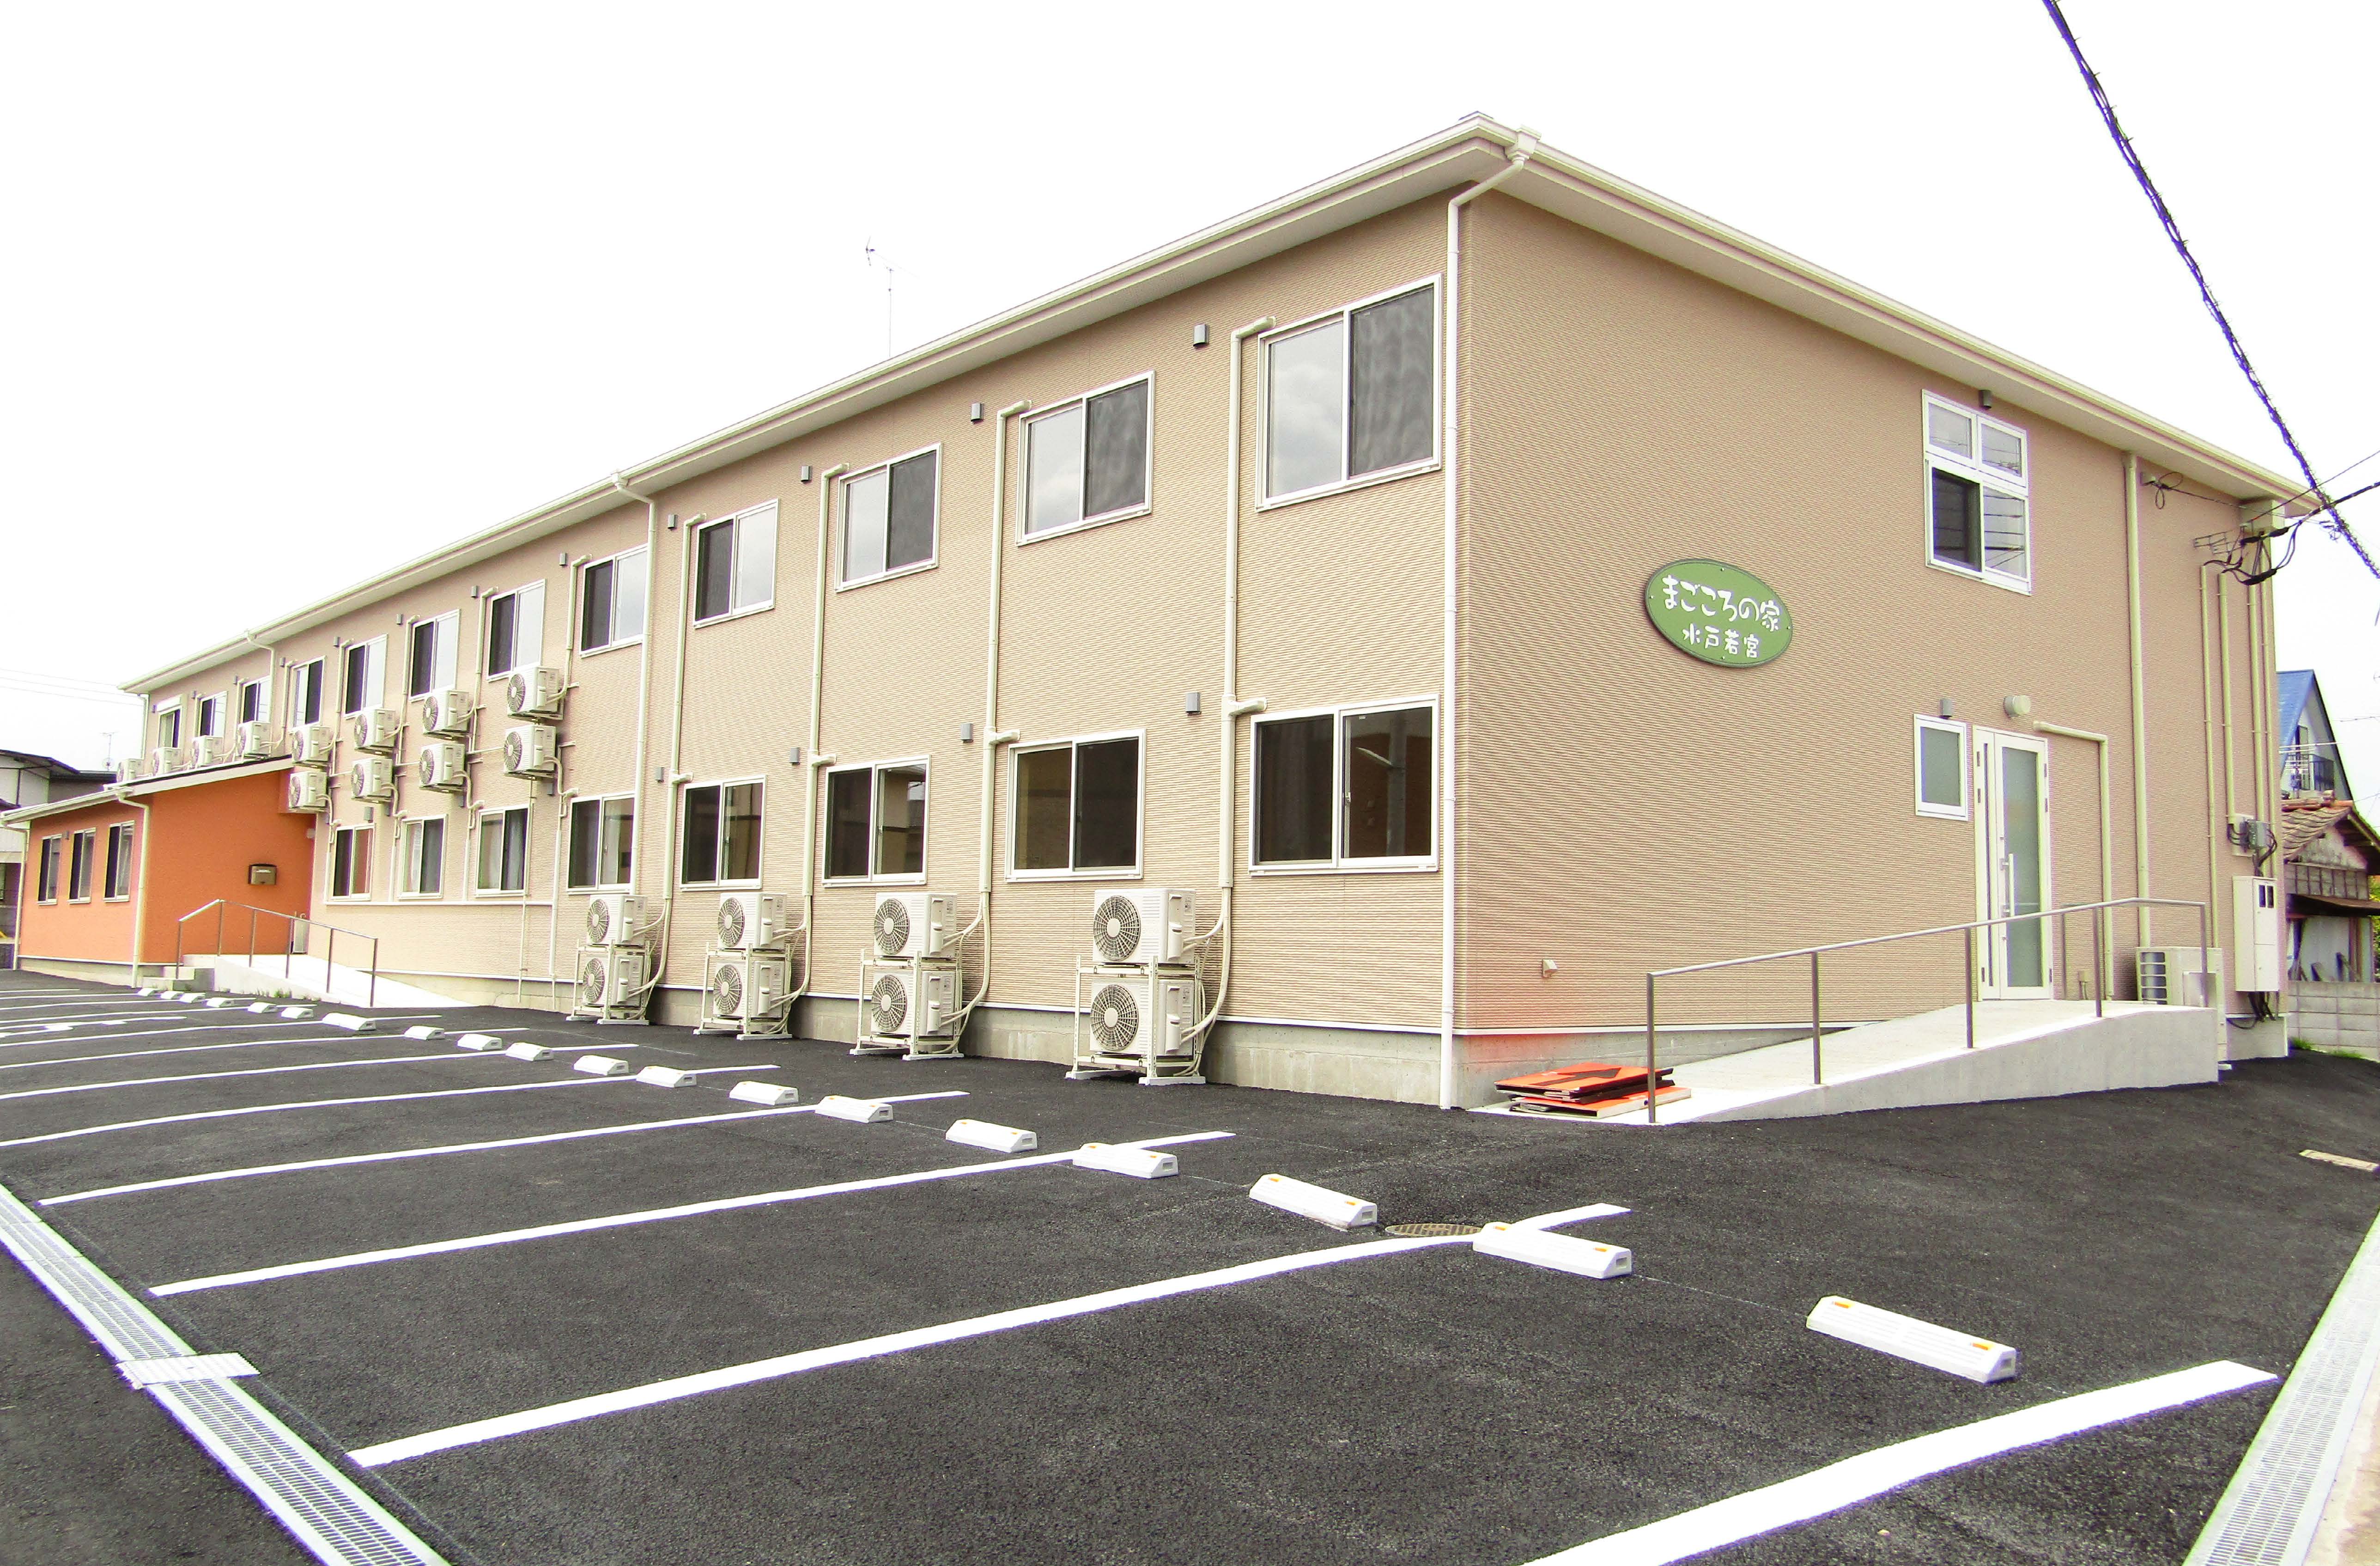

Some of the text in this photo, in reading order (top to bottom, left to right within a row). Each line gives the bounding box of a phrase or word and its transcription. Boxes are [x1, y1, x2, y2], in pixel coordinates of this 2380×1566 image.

[1662, 574, 1780, 632] まごころの家
[1682, 623, 1759, 658] 水戸若宮
